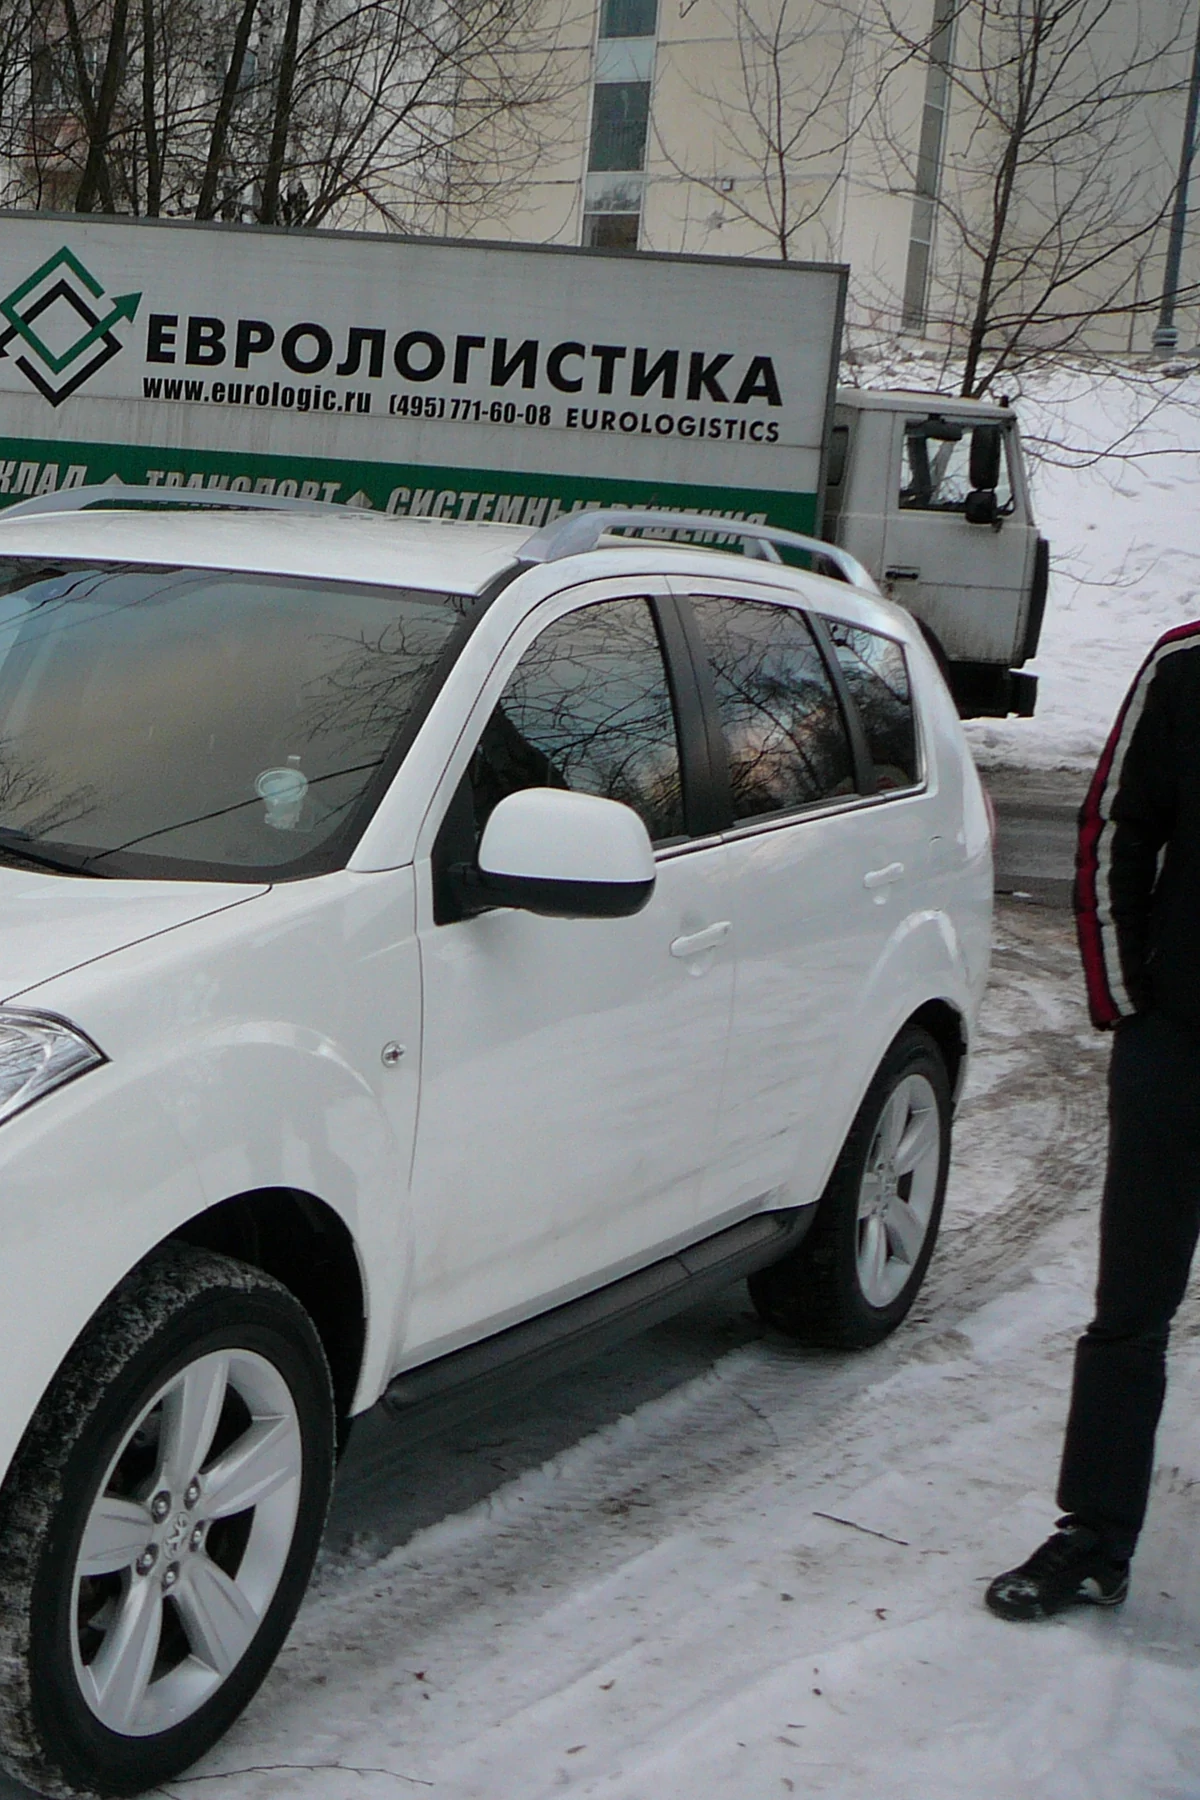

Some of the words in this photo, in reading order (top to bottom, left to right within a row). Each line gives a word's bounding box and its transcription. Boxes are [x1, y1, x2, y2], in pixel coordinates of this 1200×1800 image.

[145, 313, 783, 407] ЕВРОЛОГИСТИКА
[142, 376, 372, 414] www.eurologic.ru
[388, 393, 446, 420] (495)
[449, 398, 551, 427] 771-60-08
[566, 407, 780, 443] EUROLOGISTICS
[385, 486, 601, 527] СИСТЕМНЫ
